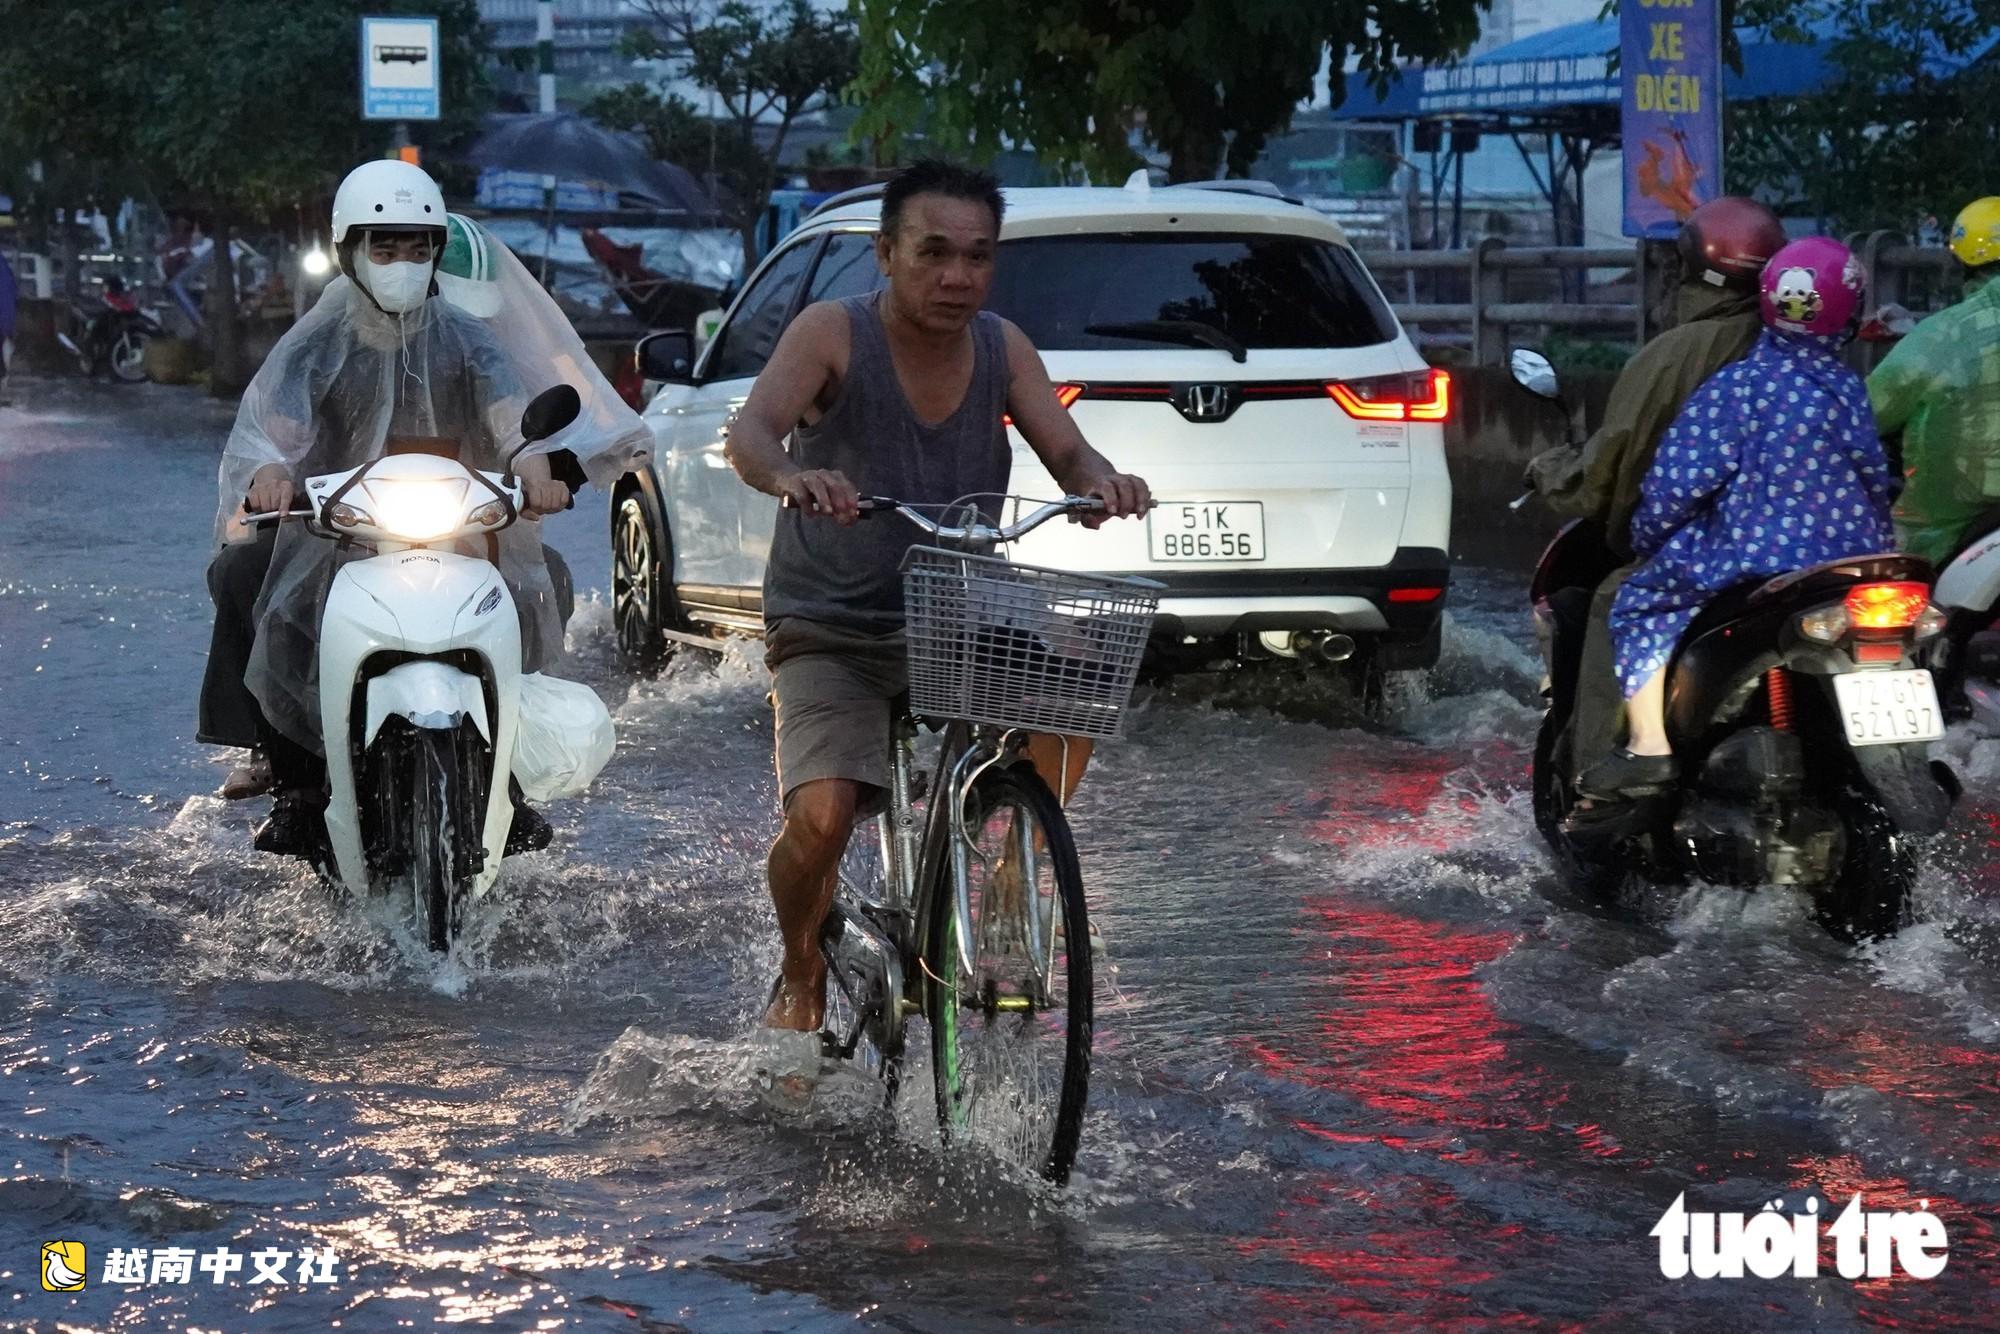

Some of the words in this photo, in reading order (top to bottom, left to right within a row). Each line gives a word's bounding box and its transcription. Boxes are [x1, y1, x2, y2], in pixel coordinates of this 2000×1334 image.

[1649, 22, 1684, 60] XE
[1636, 68, 1700, 120] ĐIỆN
[1183, 506, 1229, 529] 51K
[1164, 533, 1251, 556] 886.56
[401, 555, 440, 564] HONDA
[1850, 707, 1932, 738] 521.97
